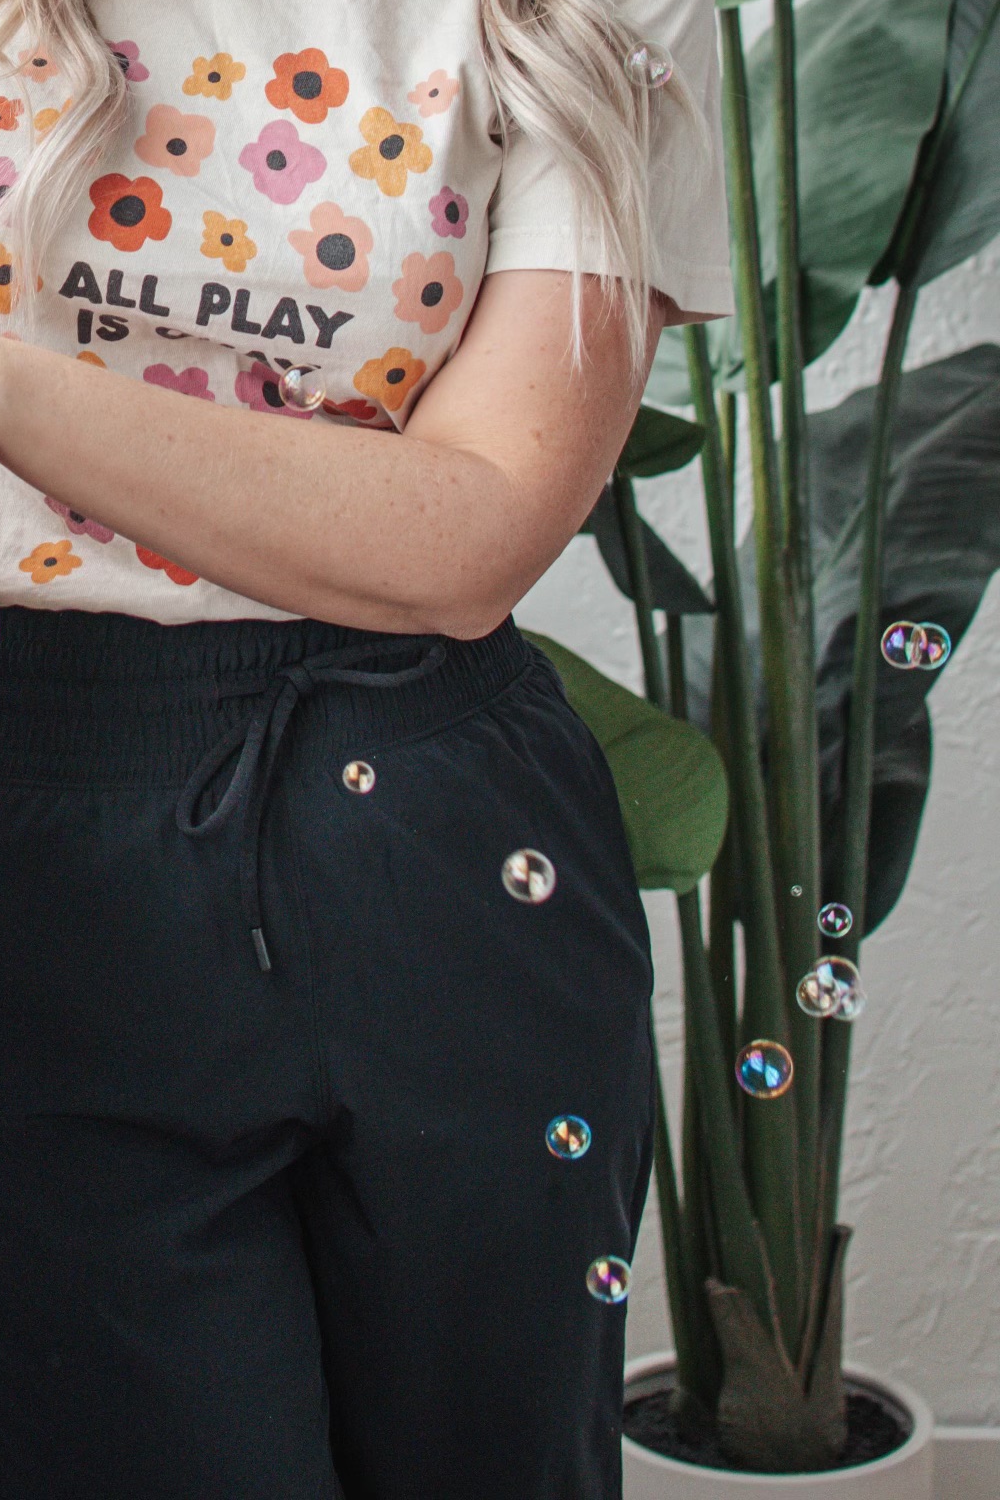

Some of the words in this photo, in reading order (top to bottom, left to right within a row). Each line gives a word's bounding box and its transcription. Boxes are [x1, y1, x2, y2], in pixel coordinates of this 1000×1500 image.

[58, 261, 170, 317] ALL
[195, 281, 355, 349] PLAY
[77, 308, 130, 344] IS
